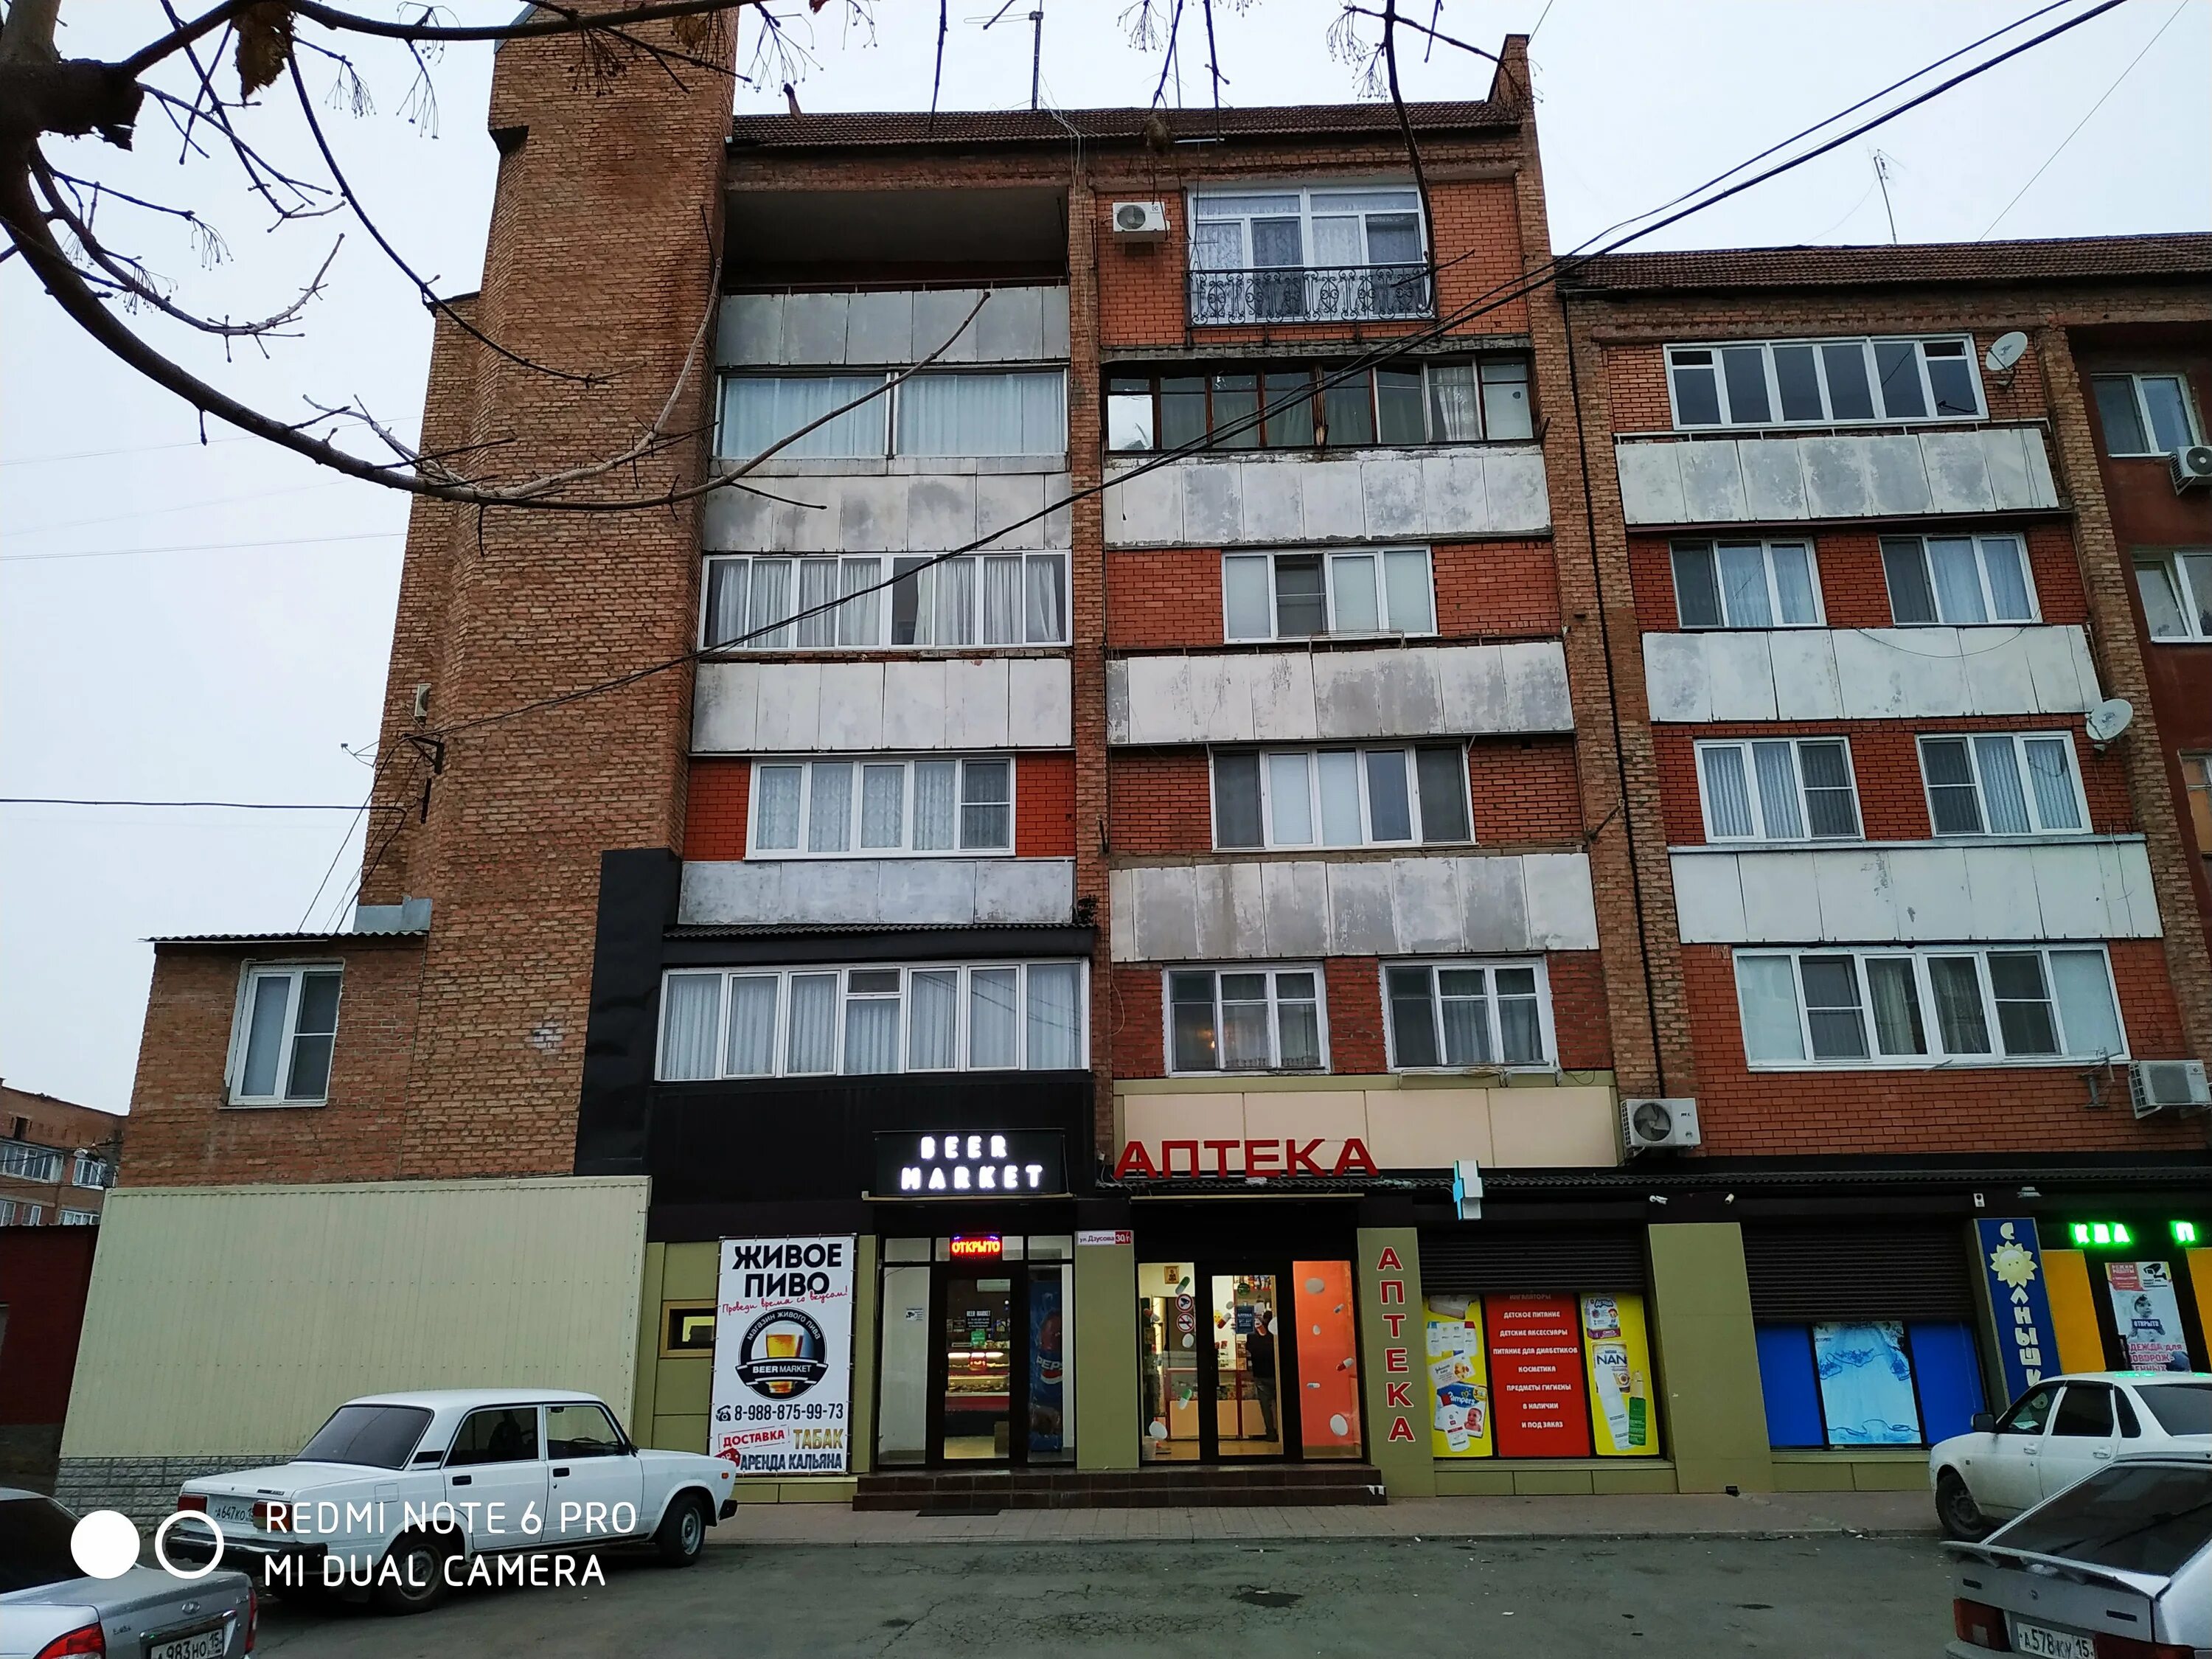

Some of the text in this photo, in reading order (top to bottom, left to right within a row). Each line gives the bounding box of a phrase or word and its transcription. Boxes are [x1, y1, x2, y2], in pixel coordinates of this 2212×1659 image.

[921, 1135, 1007, 1159] BEER
[1113, 1138, 1380, 1179] АПТЕКА
[901, 1165, 1043, 1189] MARKET
[952, 1240, 1001, 1253] ОТКРЫТО
[732, 1243, 842, 1270] ЖИВОЕ
[744, 1271, 830, 1298] ПИВО
[723, 1301, 757, 1315] Проведи
[761, 1295, 793, 1310] время
[810, 1285, 848, 1303] вкусом!
[1377, 1246, 1416, 1443] АПТЕКА
[2128, 1343, 2163, 1352] ДЕЖДА
[753, 1365, 812, 1374] BEER MARKET
[1036, 1355, 1062, 1371] PEP
[1596, 1354, 1627, 1366] NAN
[734, 1403, 844, 1421] 8-988-875-99-73
[723, 1429, 785, 1448] ДОСТАВКА
[793, 1428, 844, 1450] ТАБАК
[740, 1453, 842, 1472] АРЕНДА КАЛЬЯНА
[209, 1631, 219, 1648] 15
